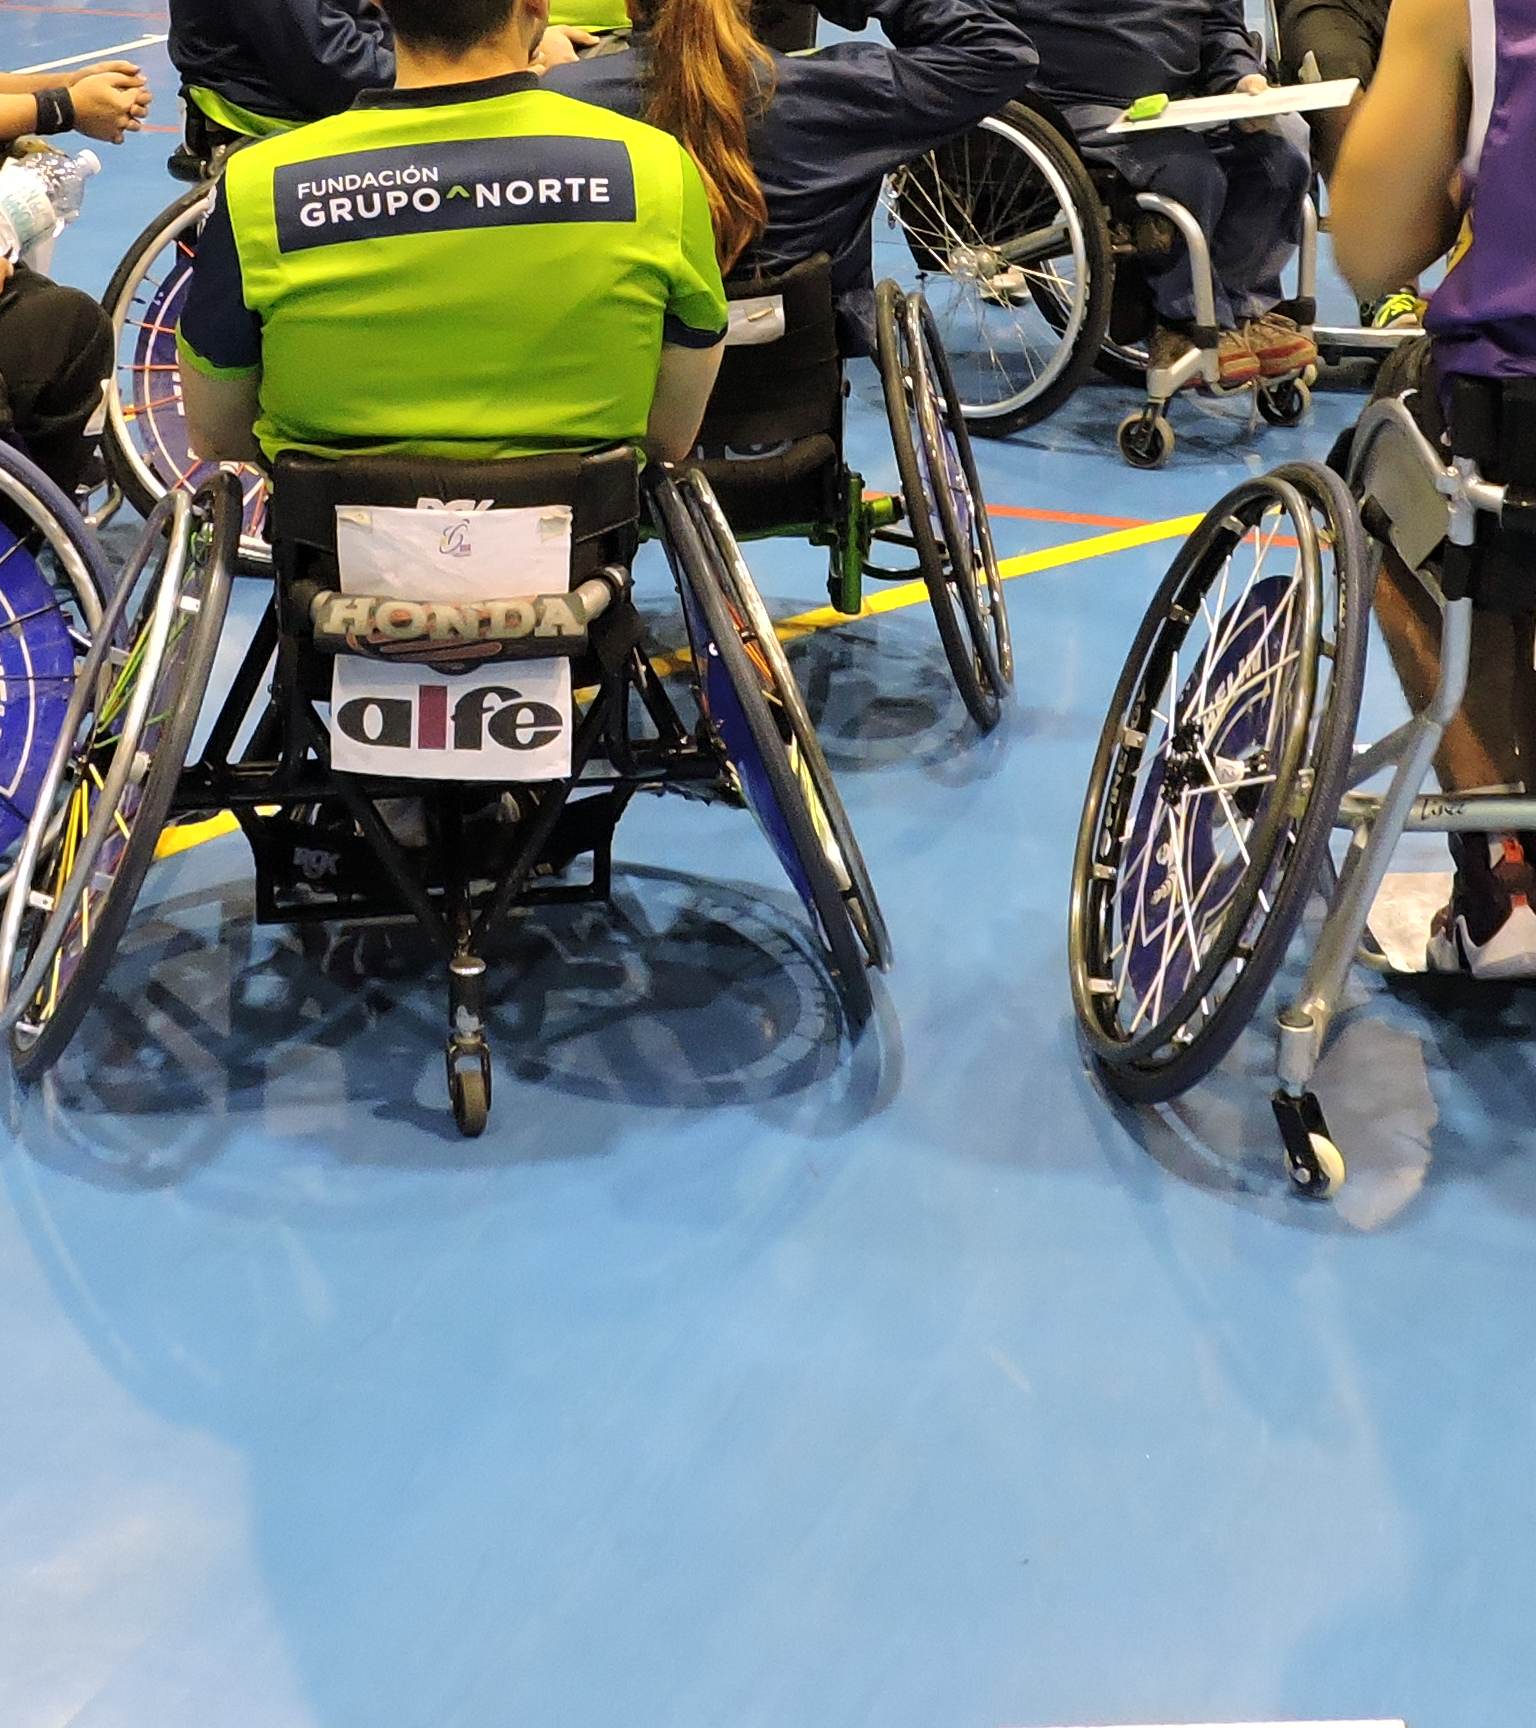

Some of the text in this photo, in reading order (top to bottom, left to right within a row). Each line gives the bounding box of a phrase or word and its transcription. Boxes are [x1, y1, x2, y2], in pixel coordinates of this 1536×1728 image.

[297, 164, 439, 200] FUNDACIÓN
[299, 176, 611, 229] GRUPO NORTE
[322, 594, 586, 640] HONDA
